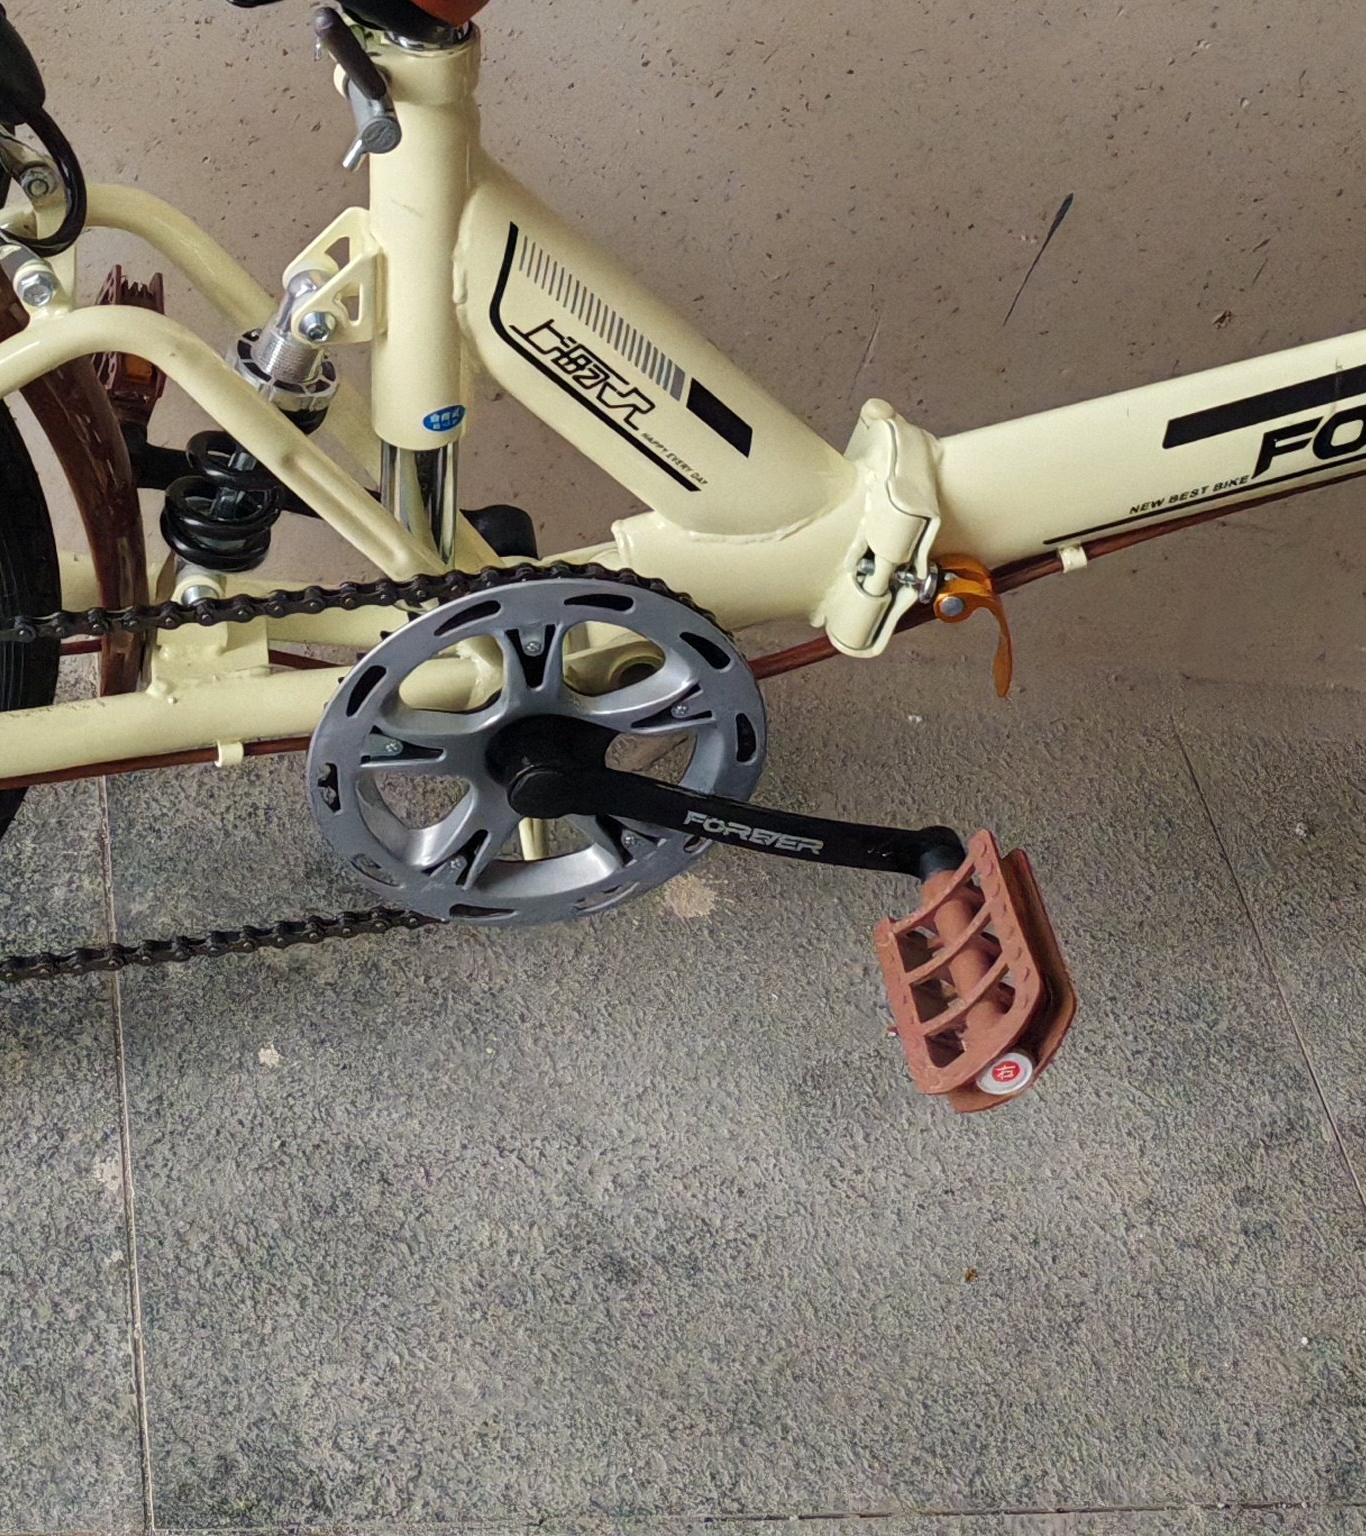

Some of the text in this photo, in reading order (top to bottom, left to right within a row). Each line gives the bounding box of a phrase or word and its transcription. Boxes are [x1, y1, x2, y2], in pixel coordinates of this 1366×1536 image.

[1129, 474, 1250, 515] NEW BEST BIKE
[682, 810, 825, 855] FOREVER
